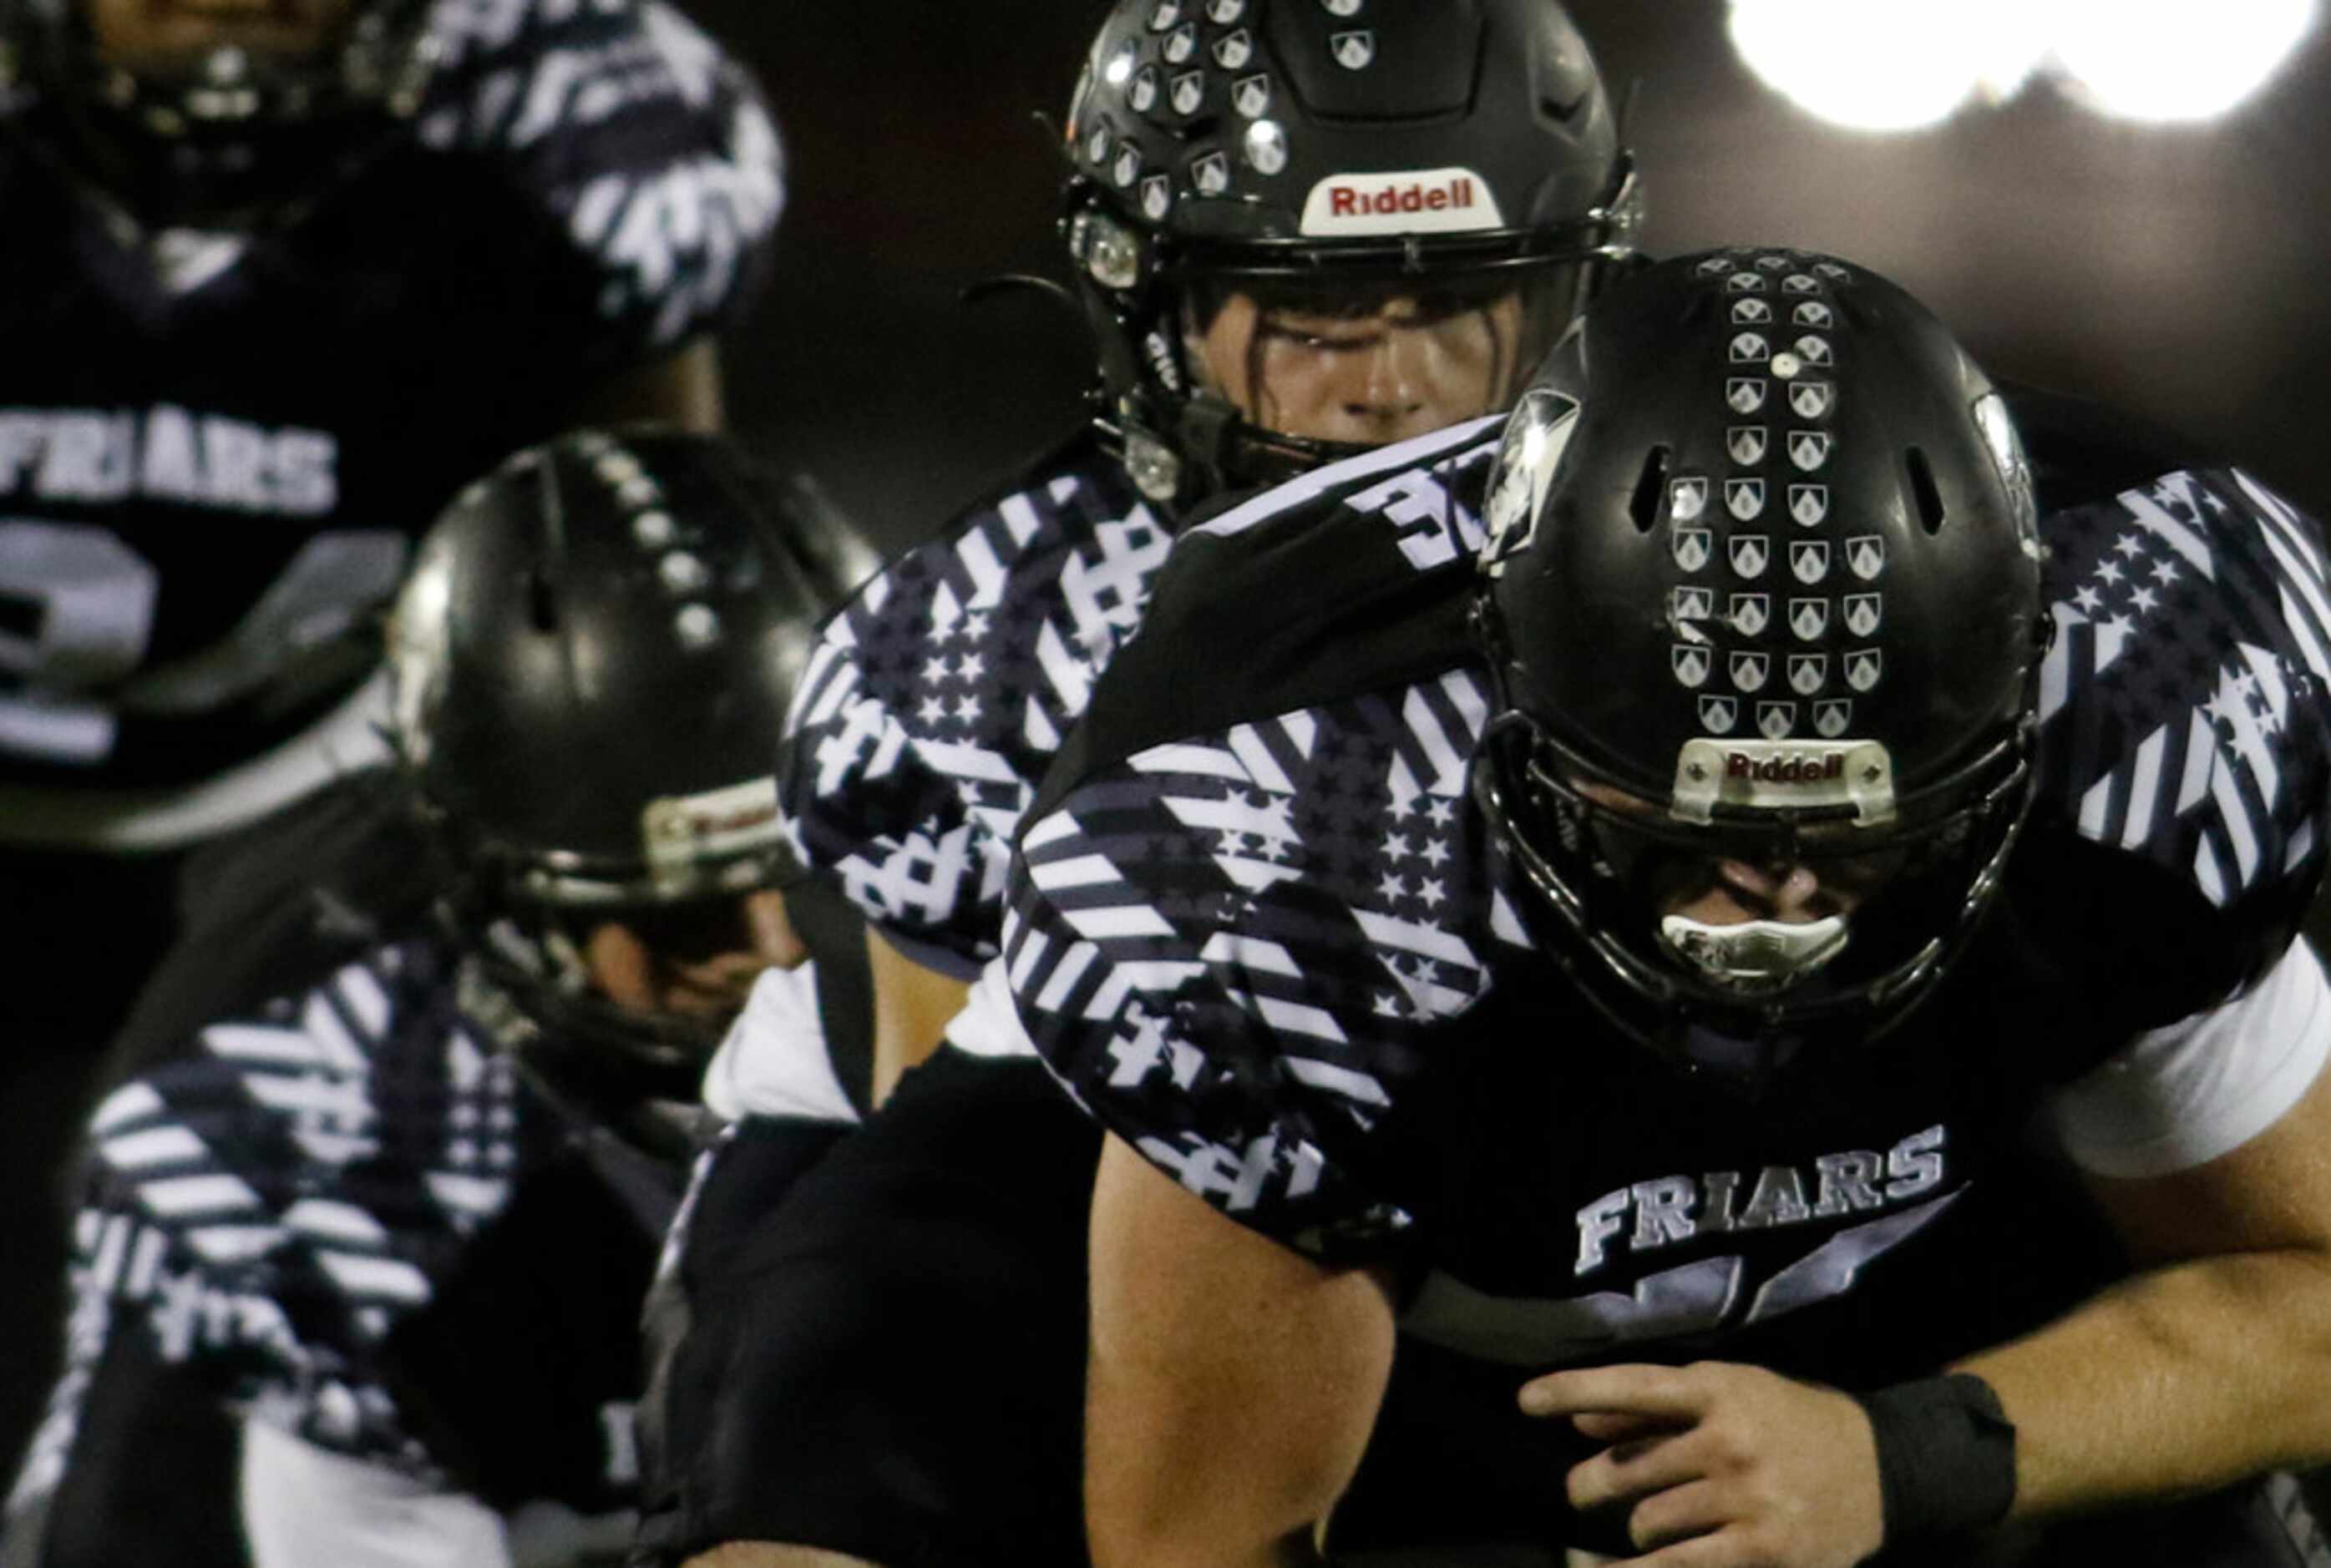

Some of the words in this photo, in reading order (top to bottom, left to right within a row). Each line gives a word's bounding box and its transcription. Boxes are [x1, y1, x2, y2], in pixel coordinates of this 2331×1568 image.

[1330, 179, 1473, 215] Riddell
[1726, 752, 1843, 781] Riddell
[1575, 1125, 1944, 1275] FRIARS
